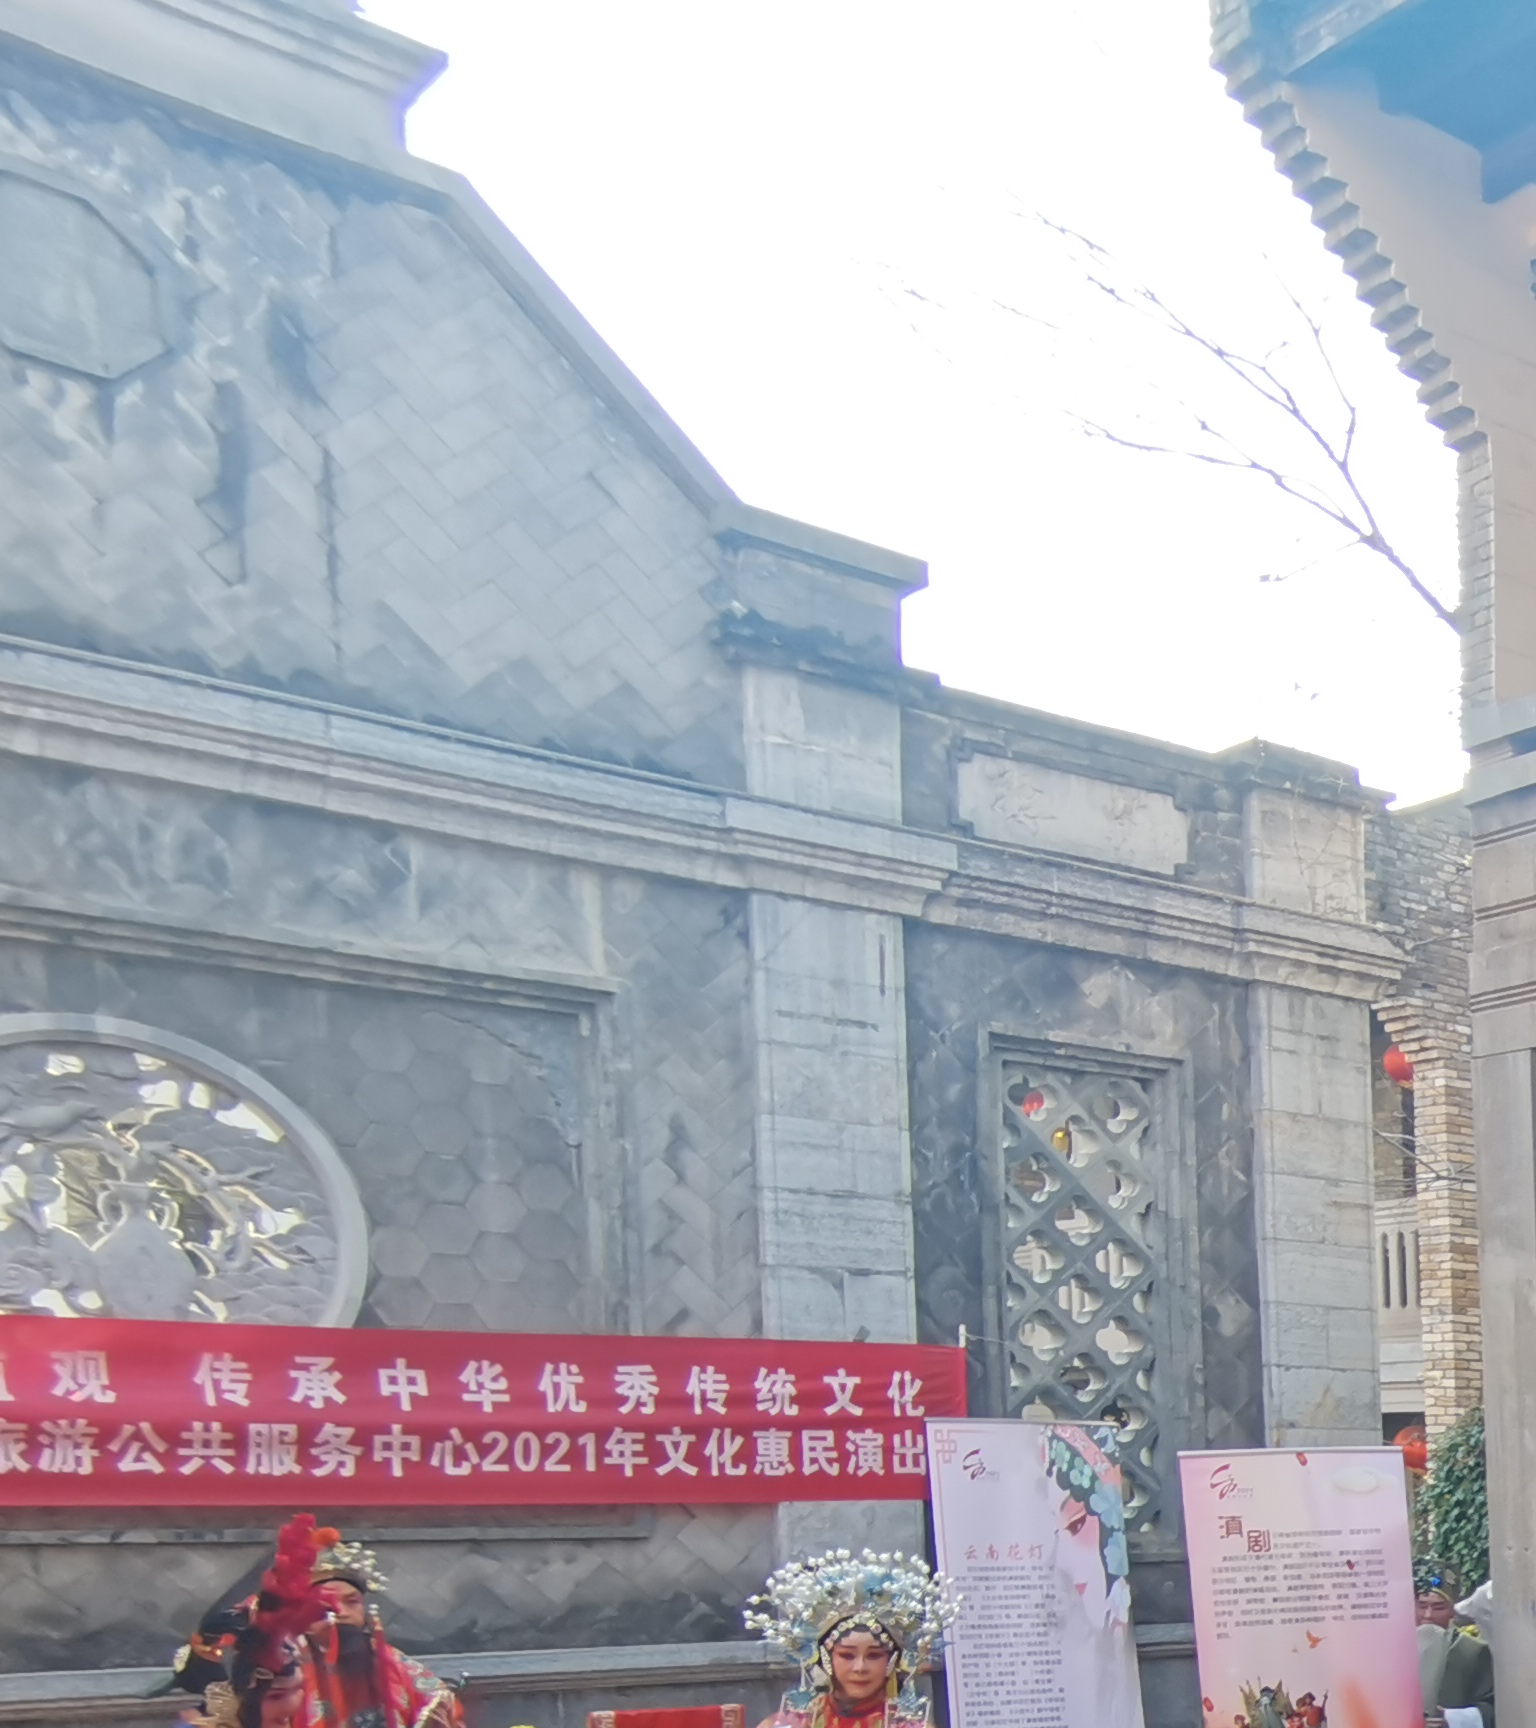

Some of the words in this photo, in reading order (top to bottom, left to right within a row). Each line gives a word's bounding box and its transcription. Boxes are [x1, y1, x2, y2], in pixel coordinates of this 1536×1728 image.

[0, 1350, 117, 1403] 观
[193, 1352, 926, 1417] 传承中华优秀传统文化
[964, 1543, 1044, 1562] 云南花灯
